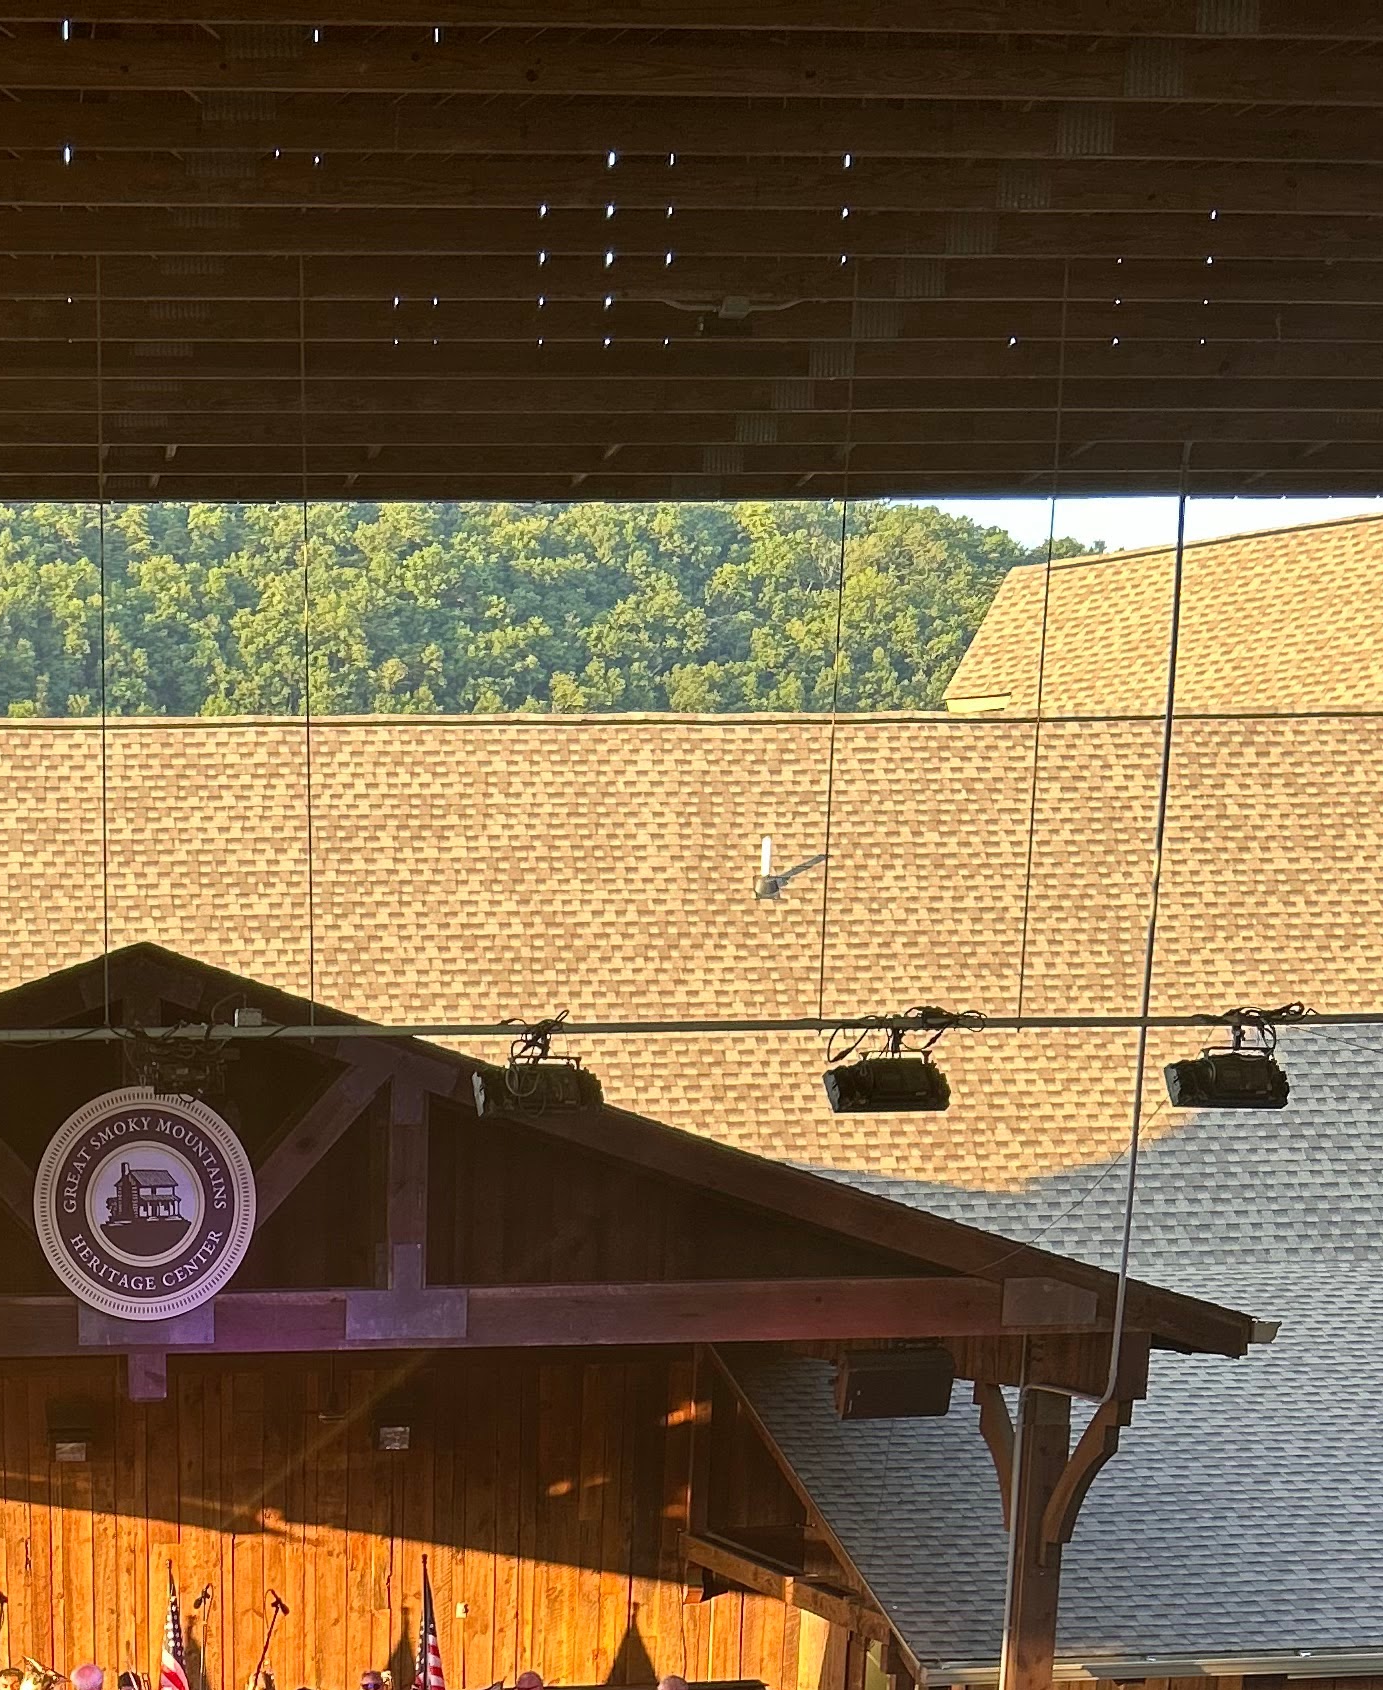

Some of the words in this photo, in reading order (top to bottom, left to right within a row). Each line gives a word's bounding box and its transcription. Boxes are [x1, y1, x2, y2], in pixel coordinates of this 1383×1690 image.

[63, 1146, 93, 1214] GREAT
[89, 1116, 153, 1151] SMOKY
[155, 1117, 227, 1209] MOUNTAINS
[69, 1232, 157, 1291] HERITAGE
[162, 1229, 223, 1288] CENTER
